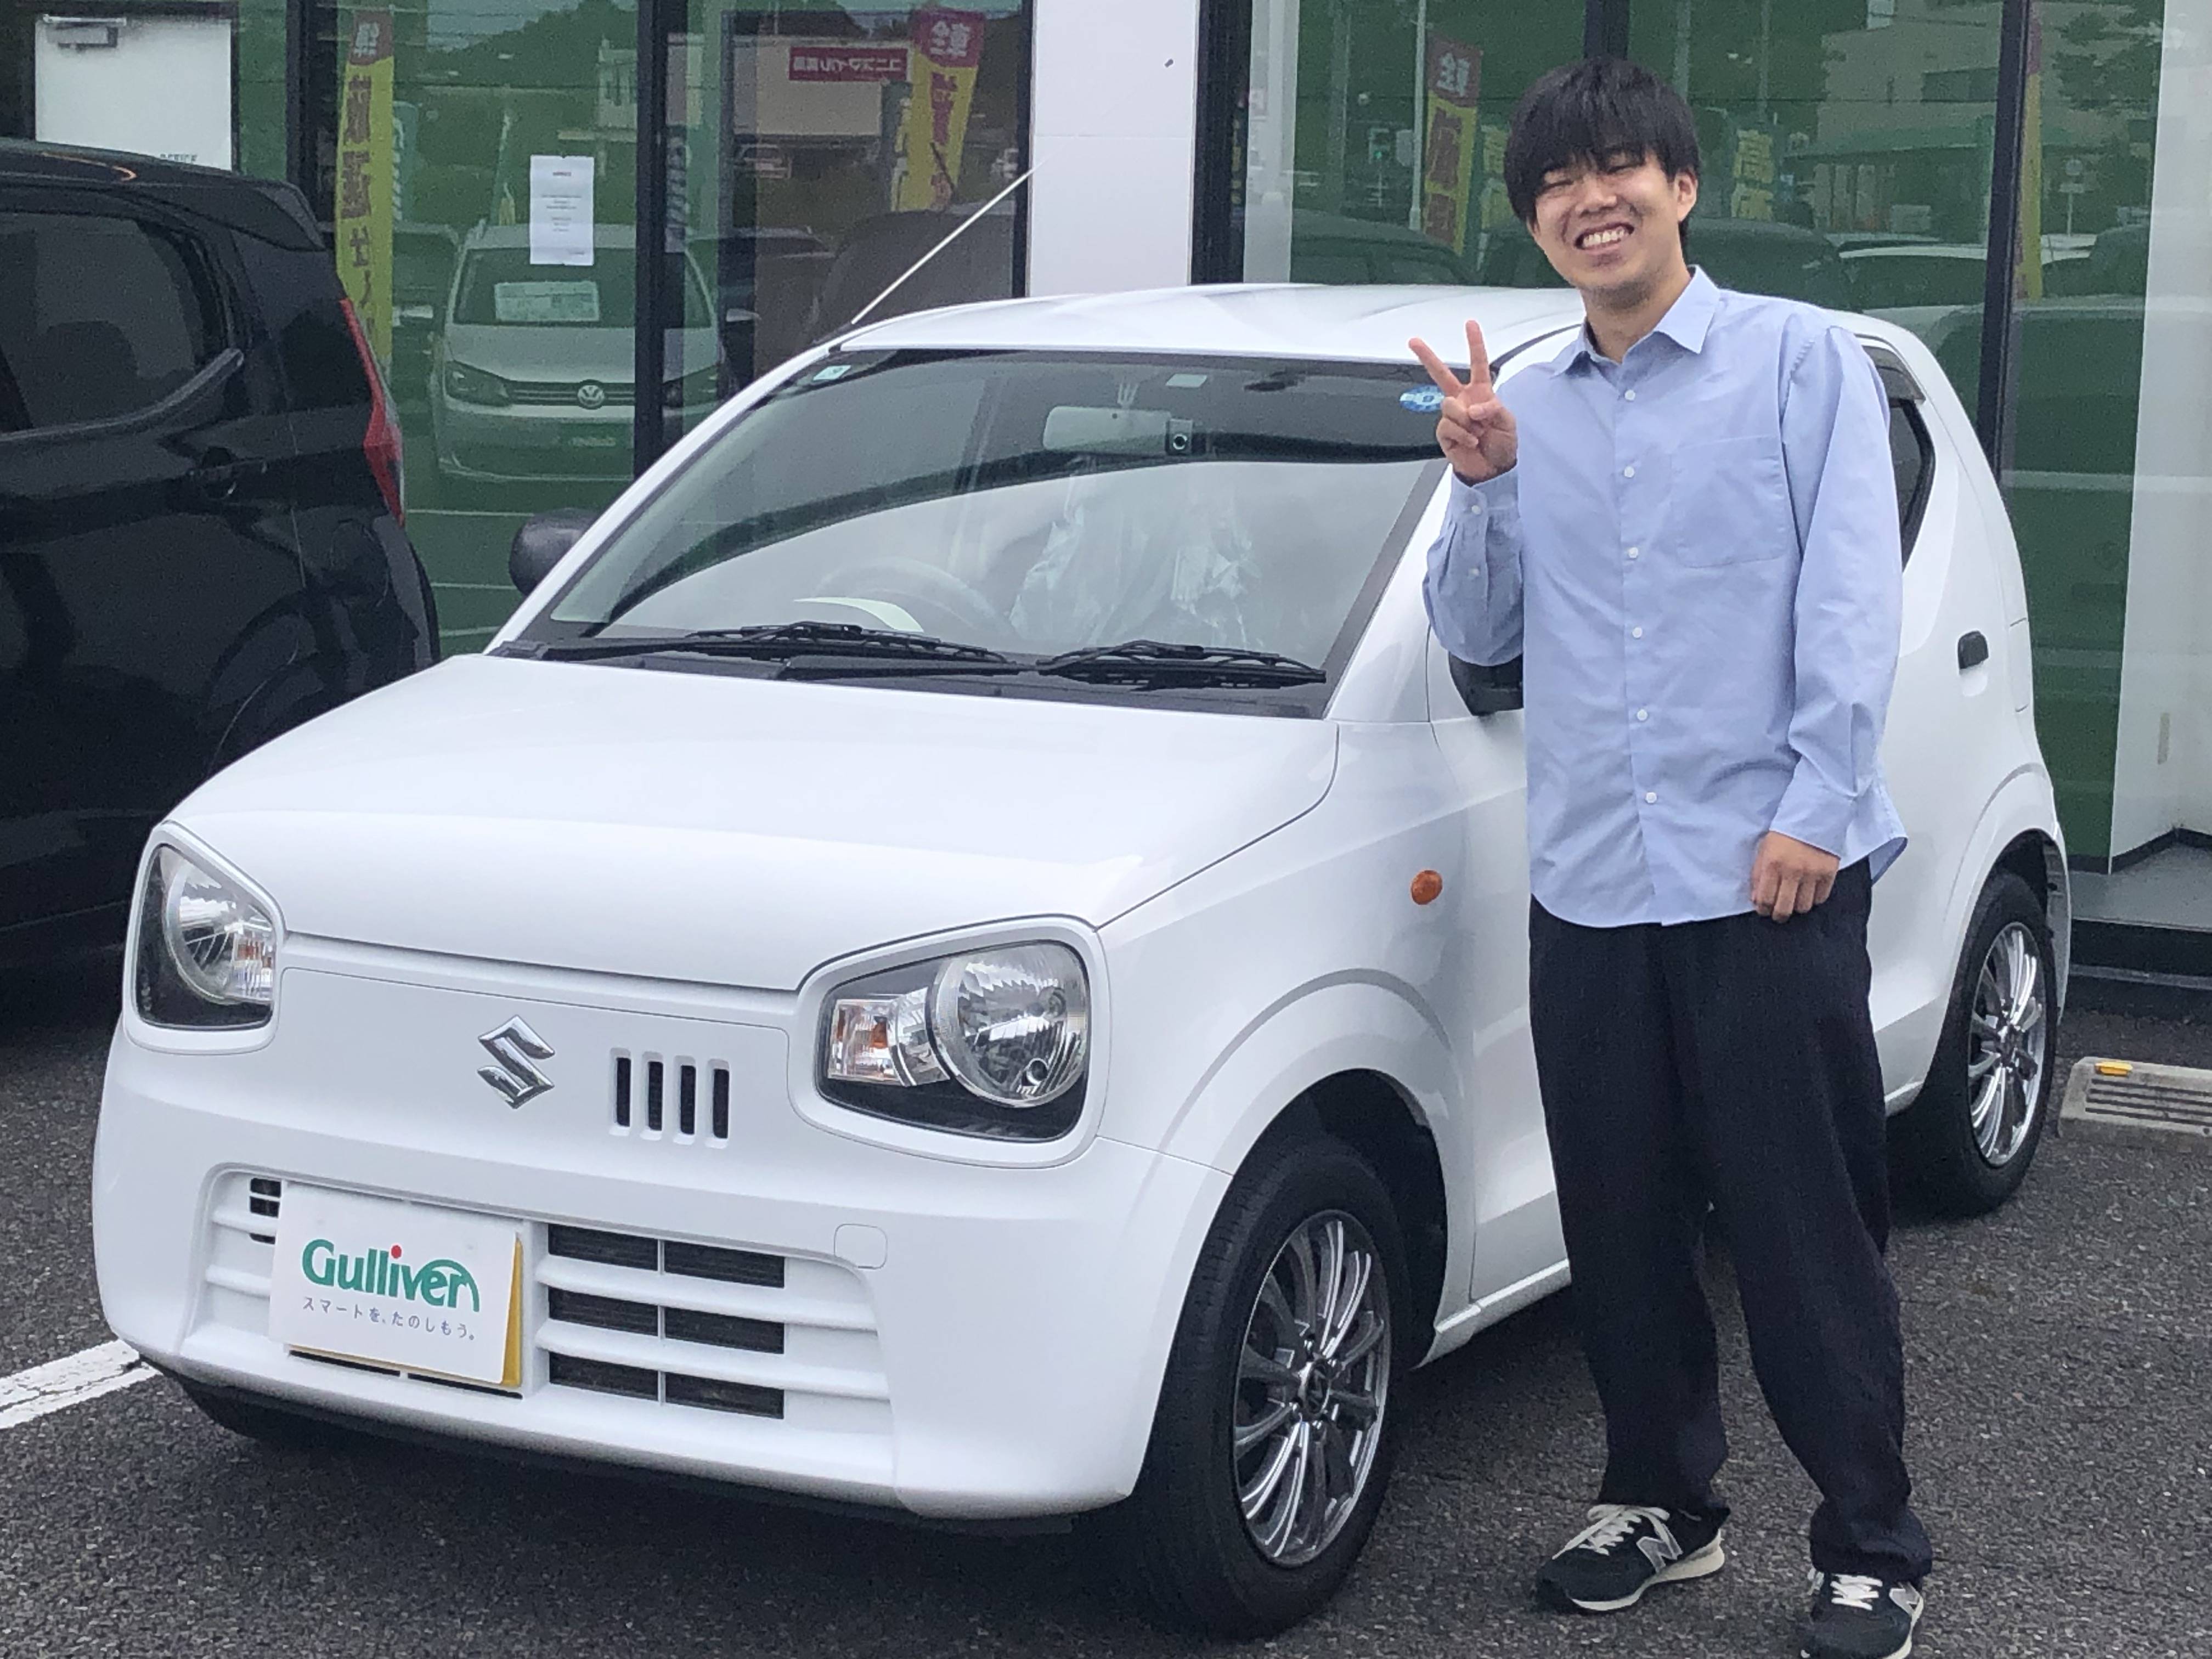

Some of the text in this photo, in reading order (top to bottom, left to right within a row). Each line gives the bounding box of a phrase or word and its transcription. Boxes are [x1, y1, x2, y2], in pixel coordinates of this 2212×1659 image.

[301, 1238, 480, 1313] Gulliver
[302, 1296, 476, 1341] スマートを、たのしもう。
